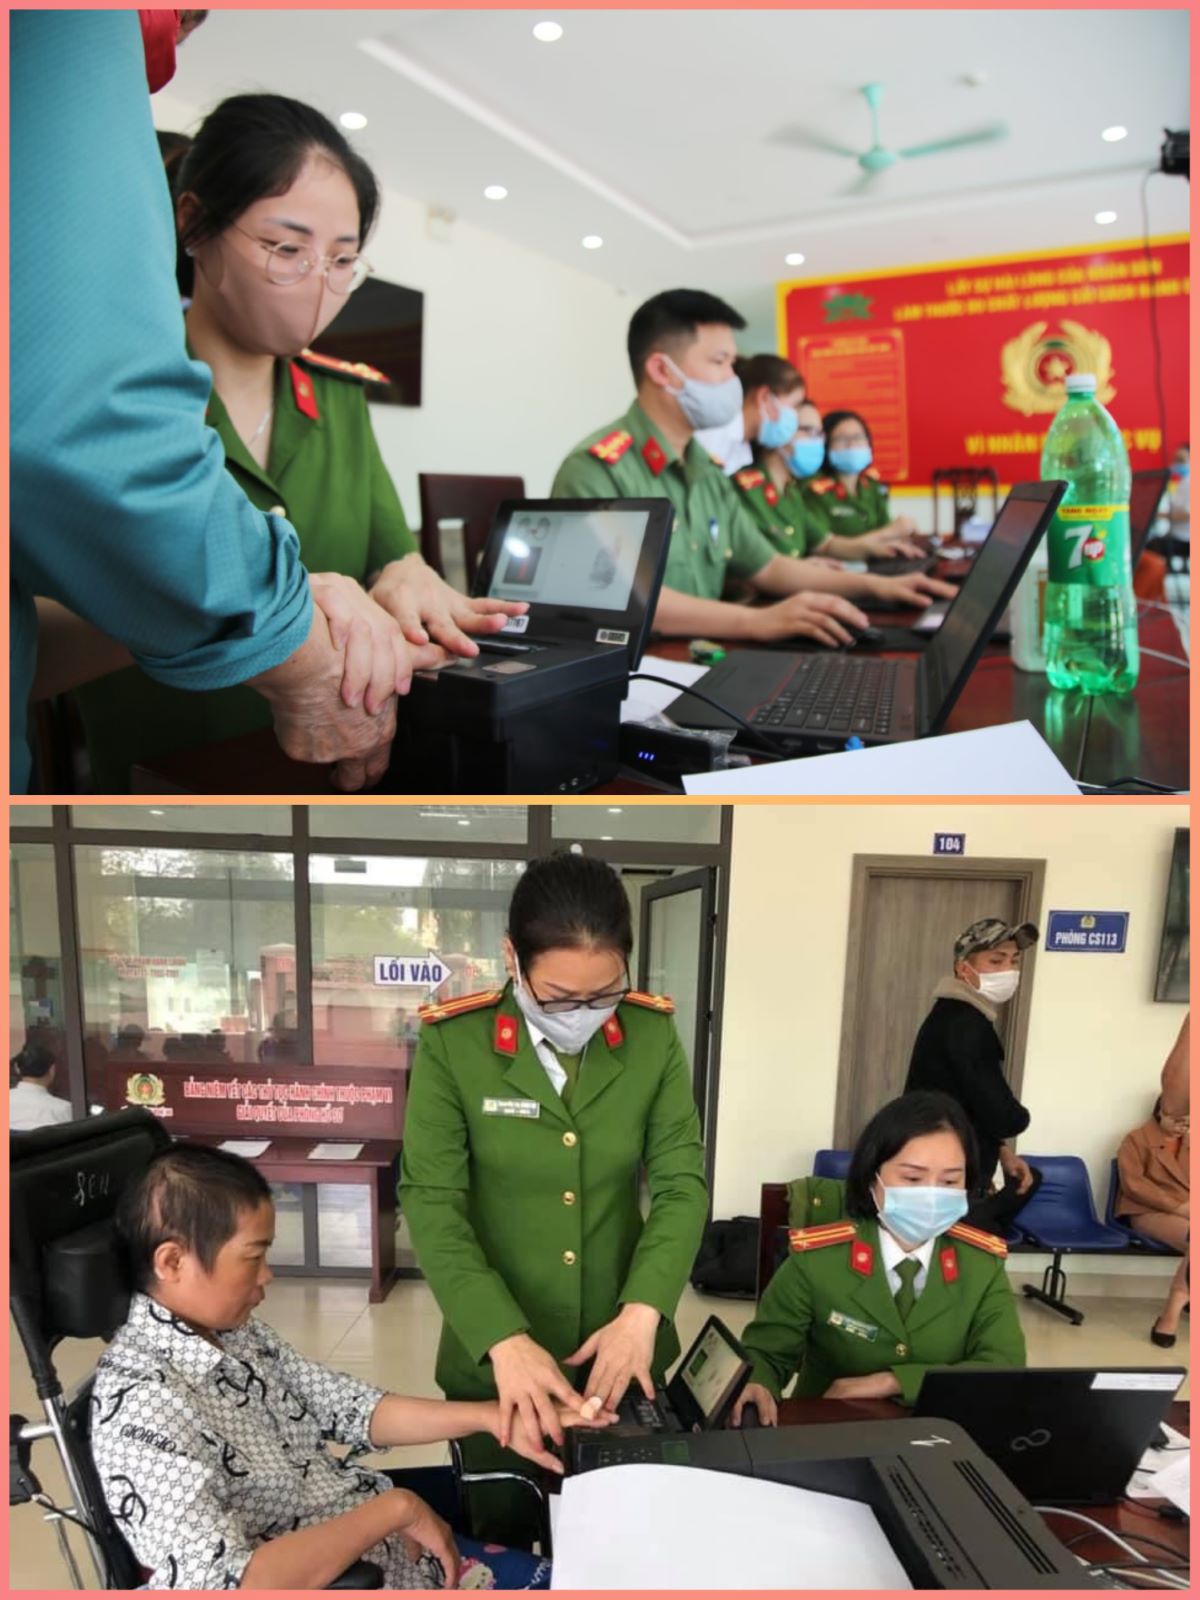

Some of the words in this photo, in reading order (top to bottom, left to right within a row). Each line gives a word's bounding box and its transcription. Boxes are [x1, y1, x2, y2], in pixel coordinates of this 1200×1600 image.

[939, 836, 960, 851] 104
[1055, 929, 1087, 945] PHÒNG
[1088, 932, 1118, 946] CS113
[379, 957, 405, 982] LỐI
[410, 960, 442, 982] VÀO
